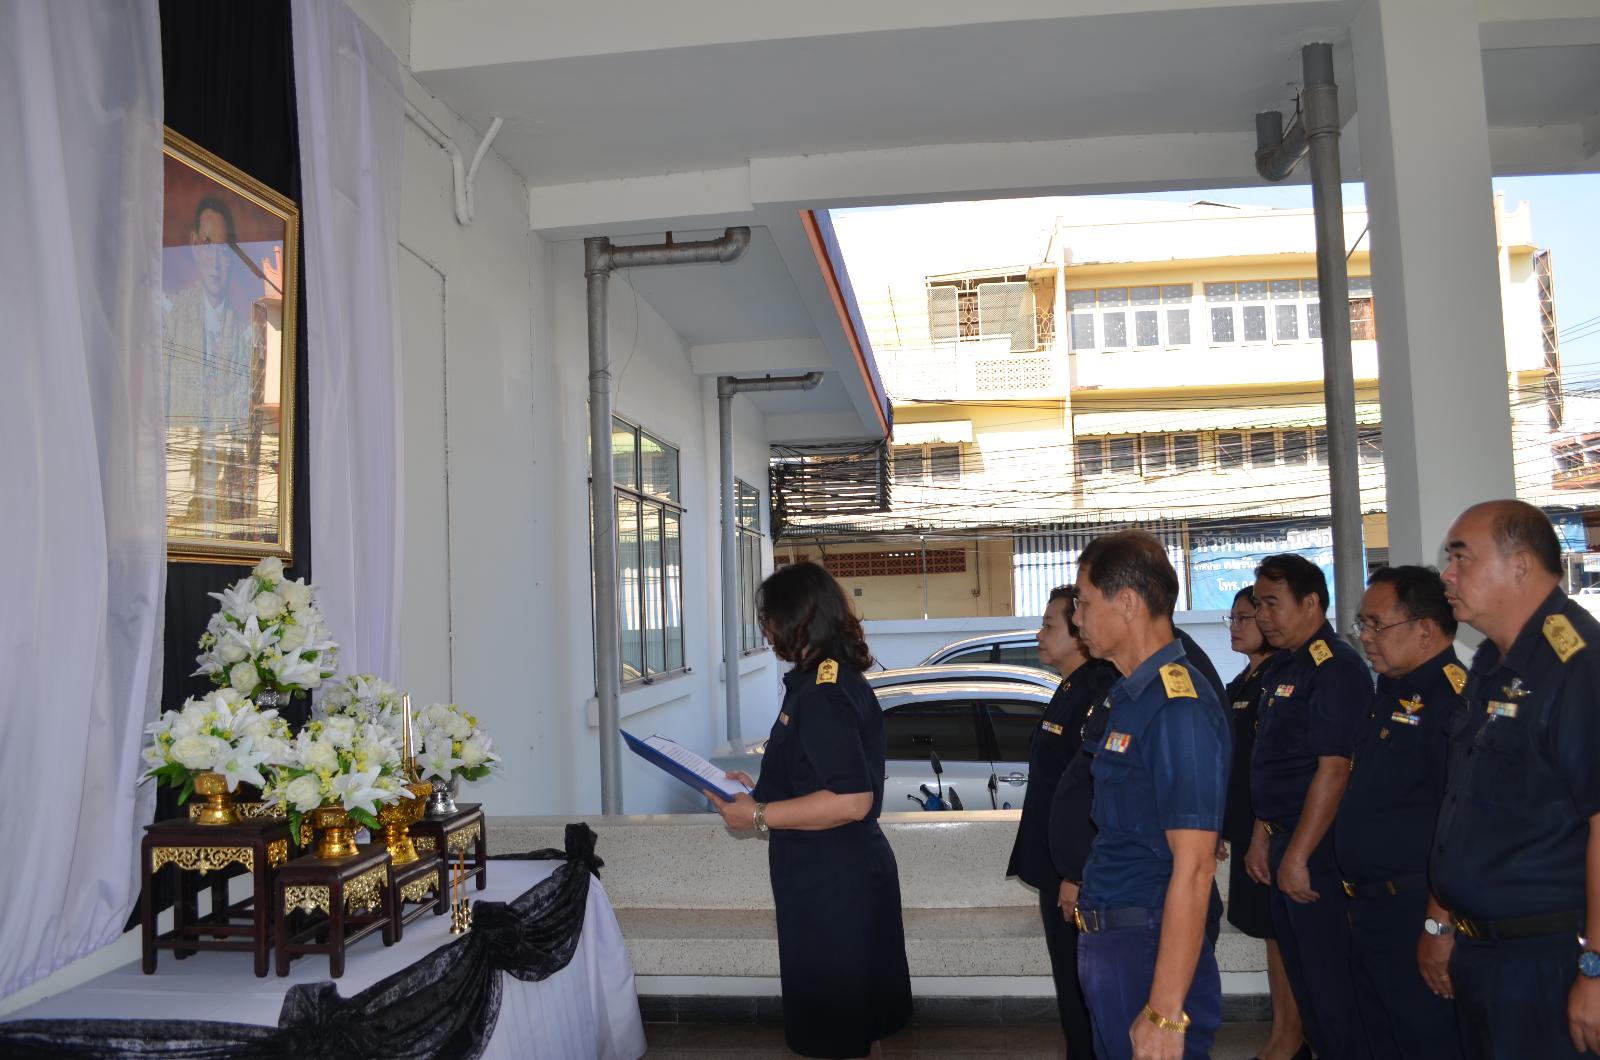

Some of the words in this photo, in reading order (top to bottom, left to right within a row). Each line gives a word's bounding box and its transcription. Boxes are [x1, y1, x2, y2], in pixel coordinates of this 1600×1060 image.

[1195, 528, 1332, 552] หัวหินเฟอร์นิเจอ
